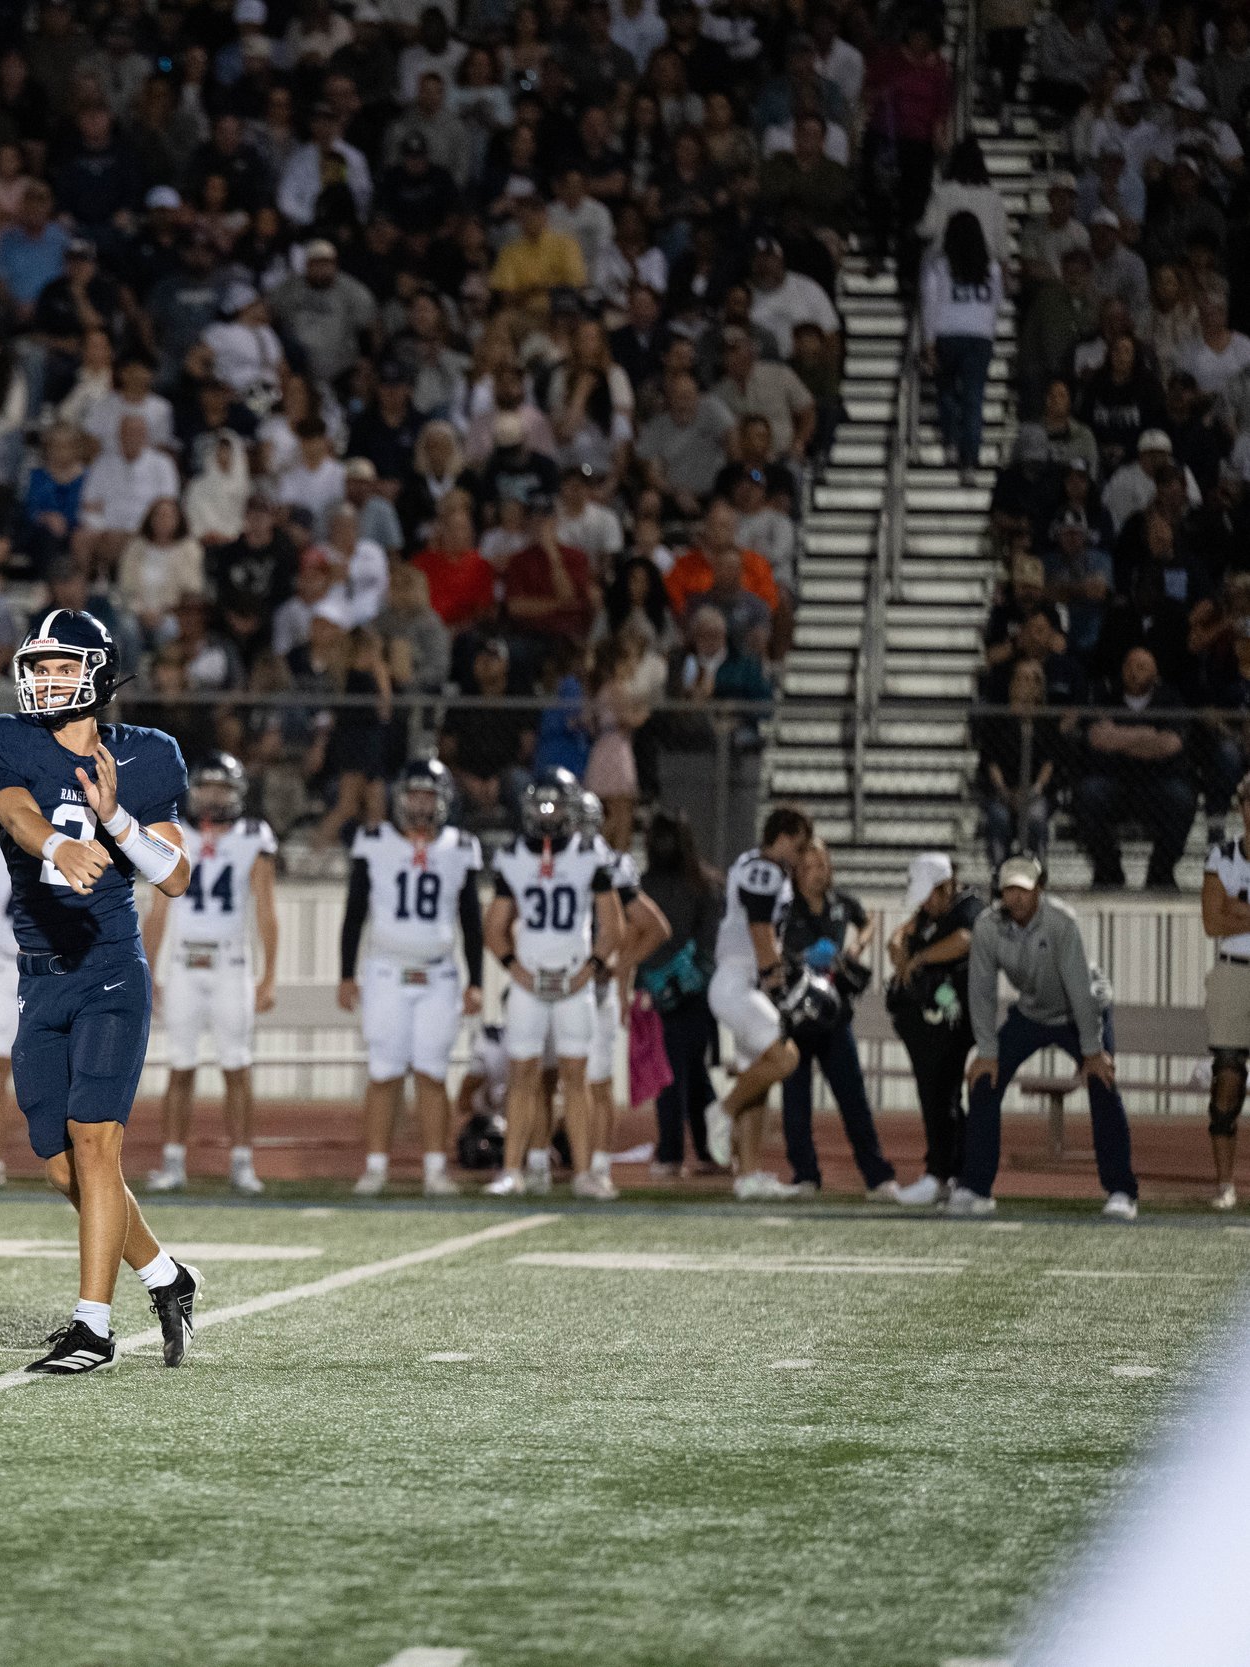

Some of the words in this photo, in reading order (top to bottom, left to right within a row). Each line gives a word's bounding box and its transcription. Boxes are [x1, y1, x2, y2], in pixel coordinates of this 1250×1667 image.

[39, 803, 98, 888] 2
[186, 863, 233, 912] 44
[395, 871, 440, 920] 18
[524, 886, 578, 931] 30
